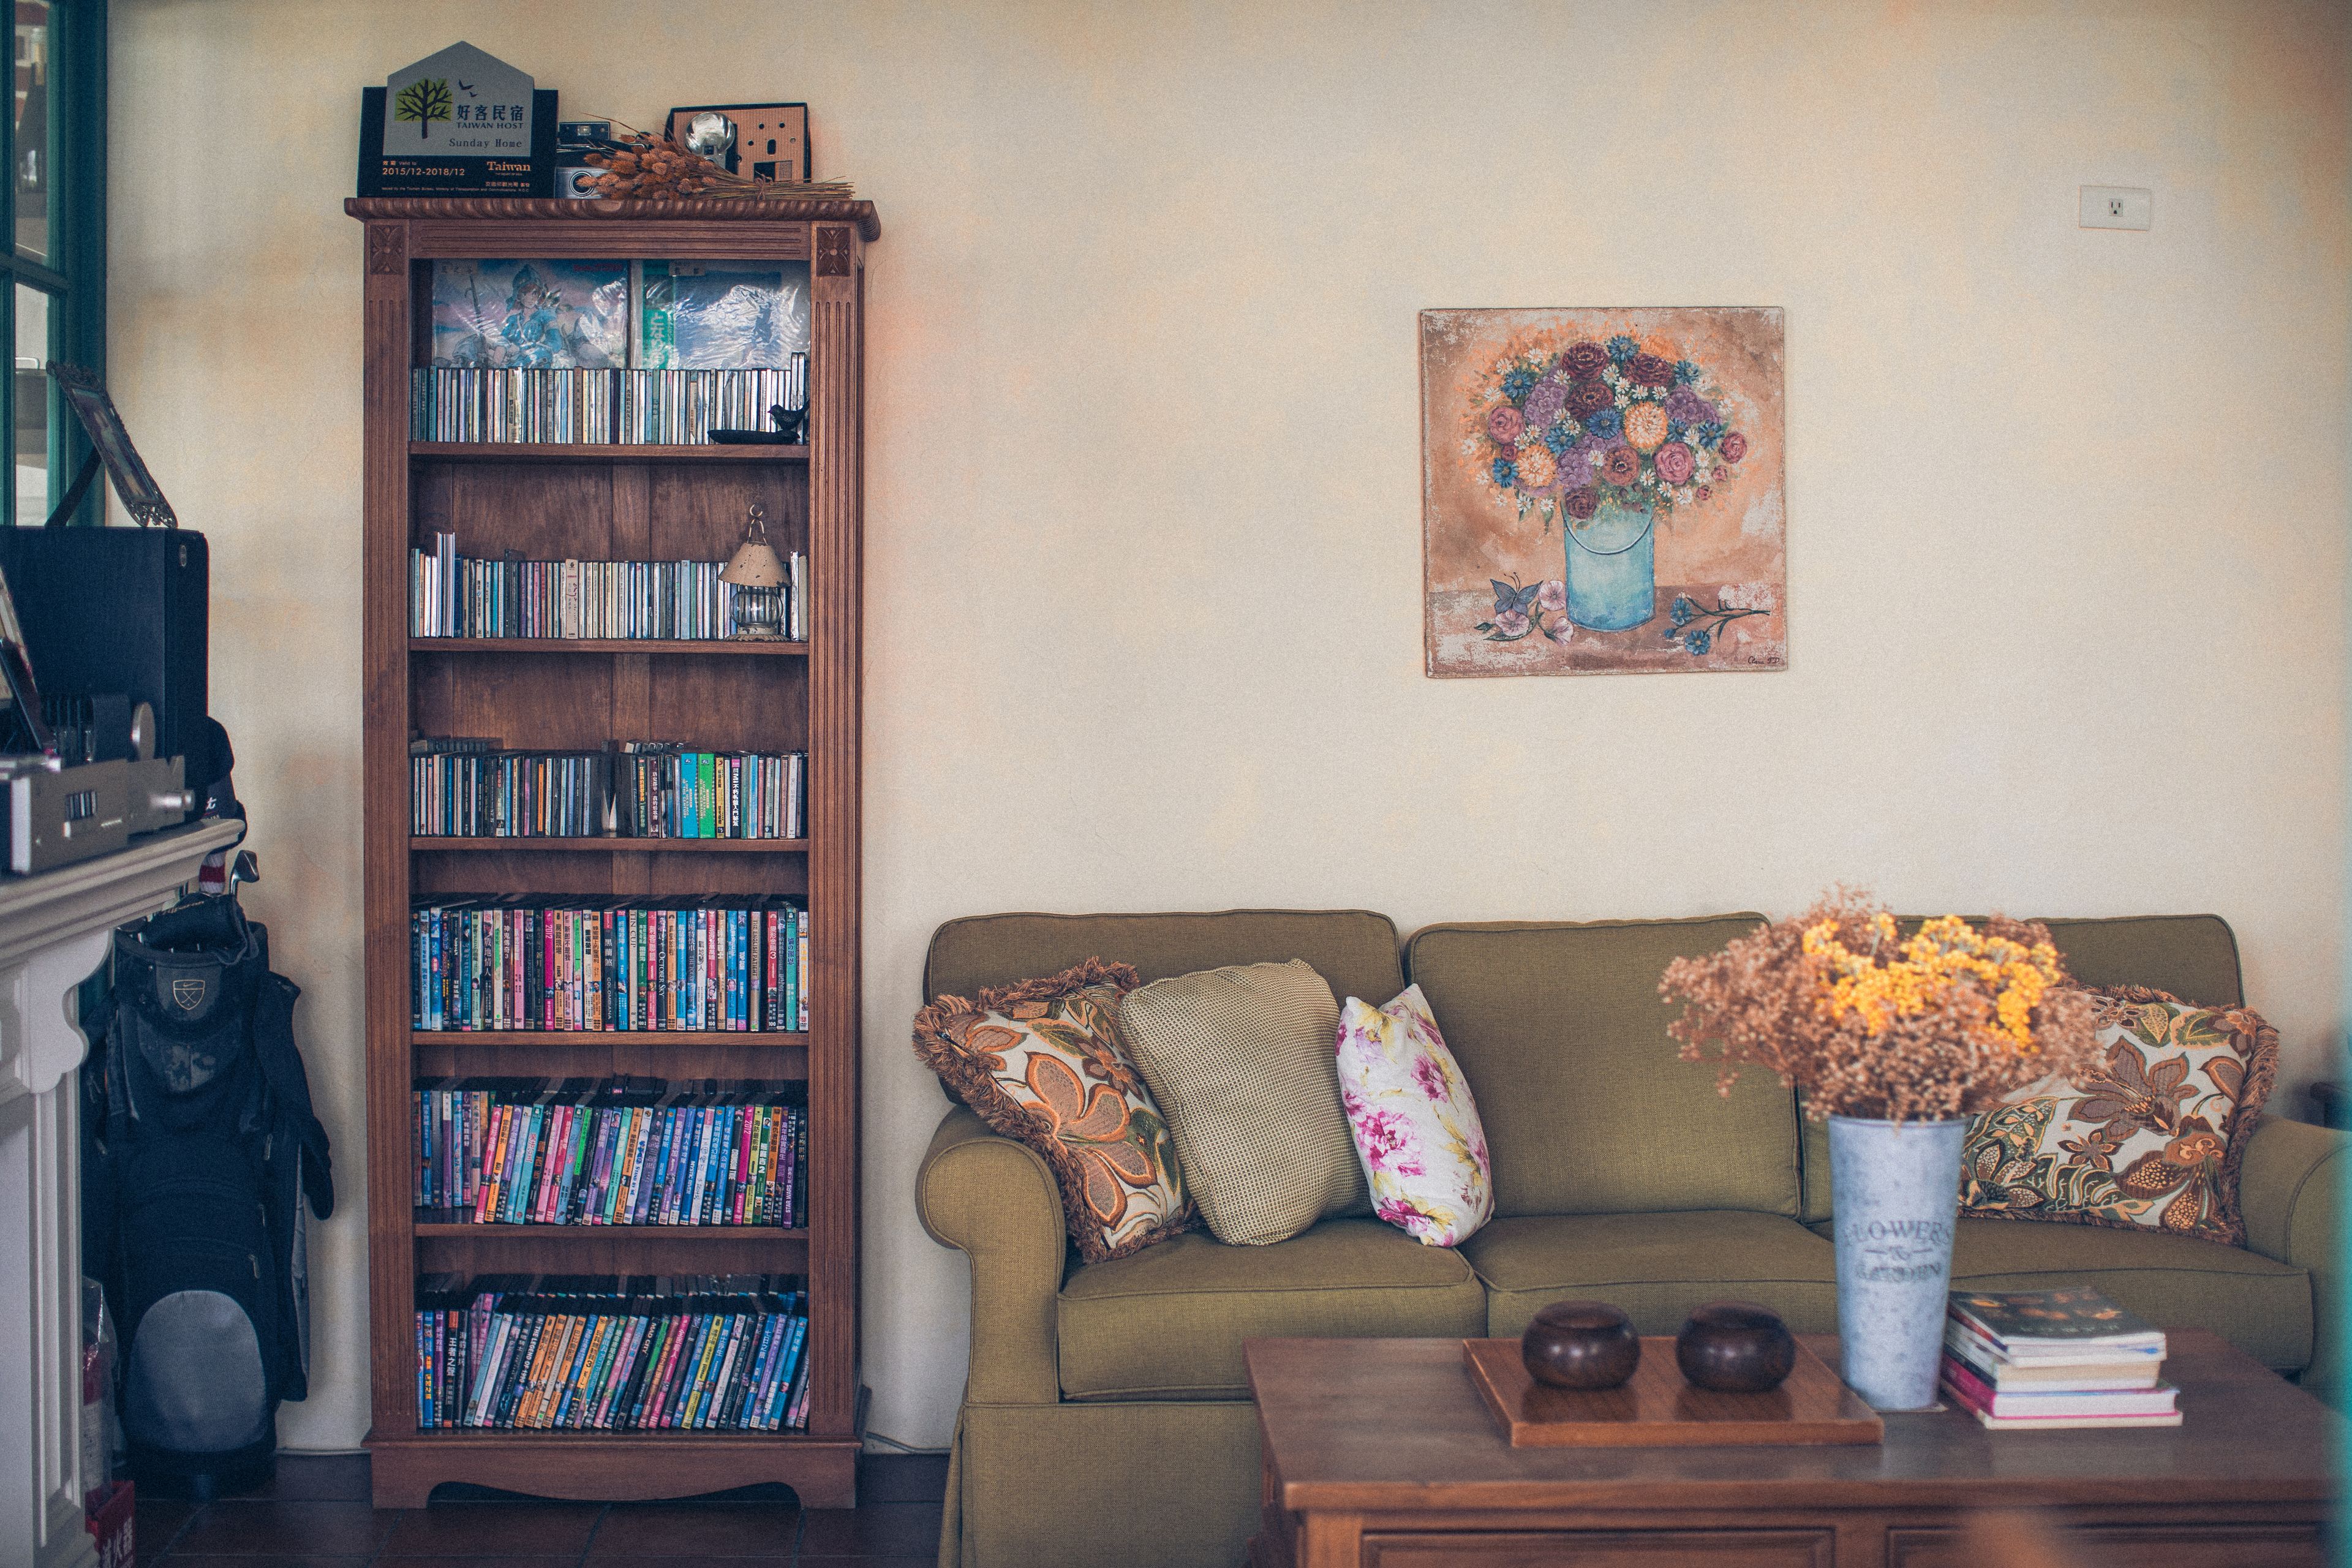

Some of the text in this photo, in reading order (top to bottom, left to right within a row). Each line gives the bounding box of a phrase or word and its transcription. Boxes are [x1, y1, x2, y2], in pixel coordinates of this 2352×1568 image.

[457, 104, 524, 121] 好客民宿
[449, 138, 522, 148] Sunday Home
[382, 168, 465, 176] 2015/12-2018/12
[486, 161, 530, 172] Taiwan
[744, 1120, 753, 1134] 2012
[532, 1325, 541, 1338] THE
[642, 1322, 657, 1355] MAD CITY
[526, 1338, 538, 1360] LEGEND
[524, 1360, 530, 1369] OF
